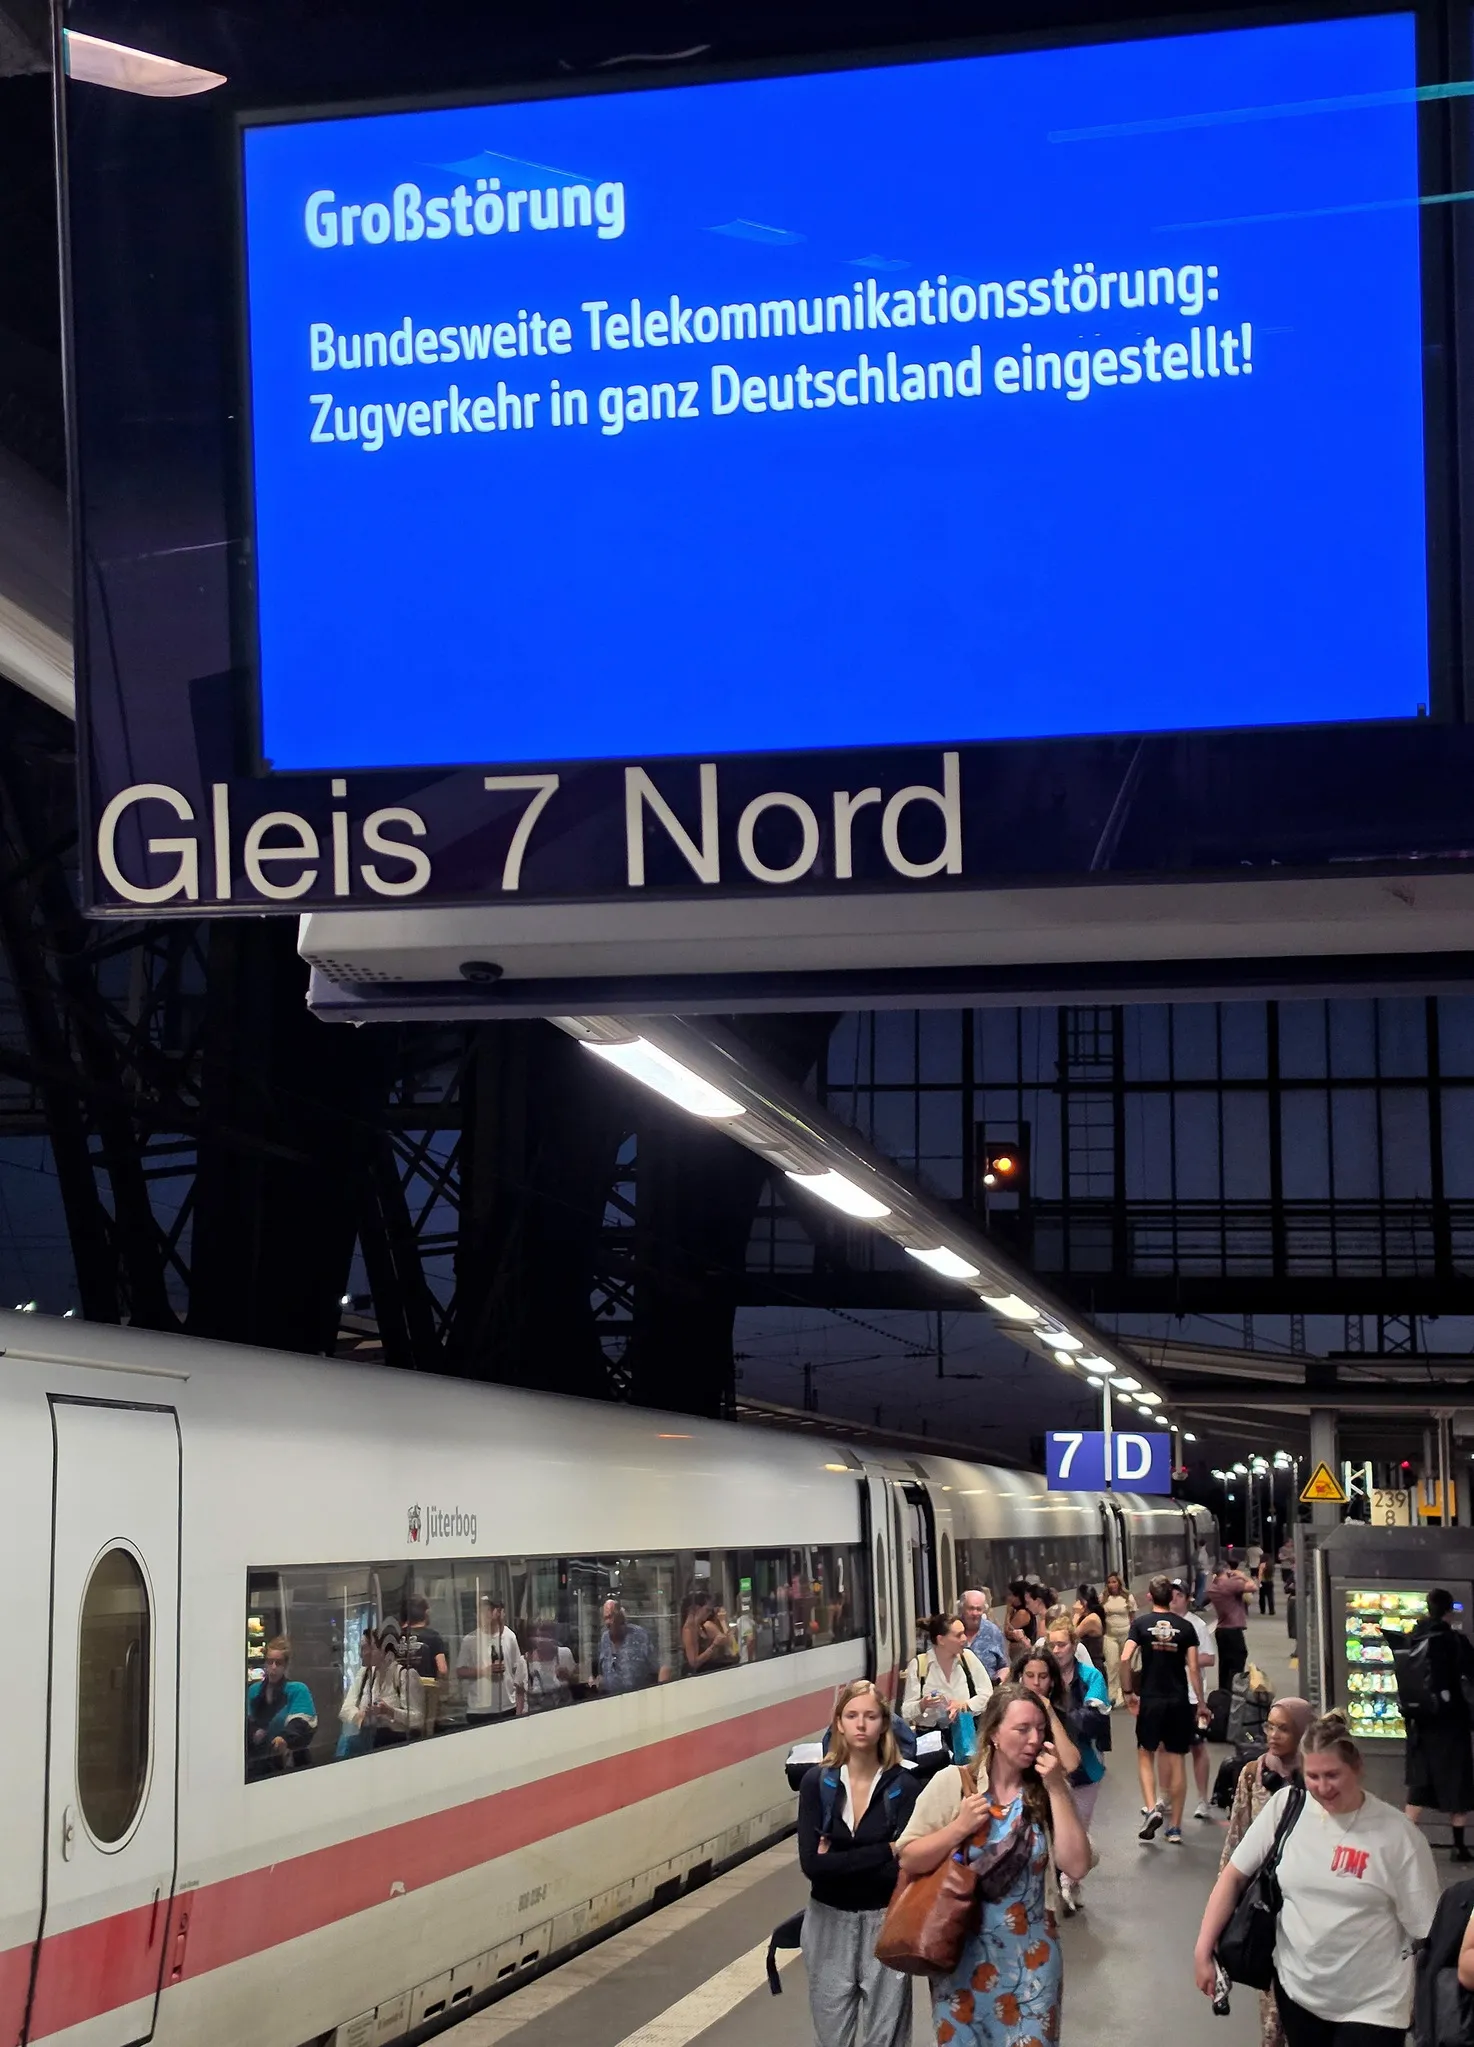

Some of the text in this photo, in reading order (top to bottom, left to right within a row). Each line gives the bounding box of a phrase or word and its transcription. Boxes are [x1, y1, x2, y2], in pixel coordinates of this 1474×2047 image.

[305, 178, 625, 248] Großstörung
[311, 263, 1218, 371] Bundesweite Telekommunikationsstörung:
[310, 323, 1252, 451] Zugverkehr in ganz Deutschland eingestellt!
[99, 752, 962, 904] Gleis 7 Nord
[1053, 1432, 1152, 1480] 7 D
[425, 1505, 477, 1546] Jüterbog
[1374, 1491, 1407, 1508] 239
[1385, 1510, 1396, 1526] 8
